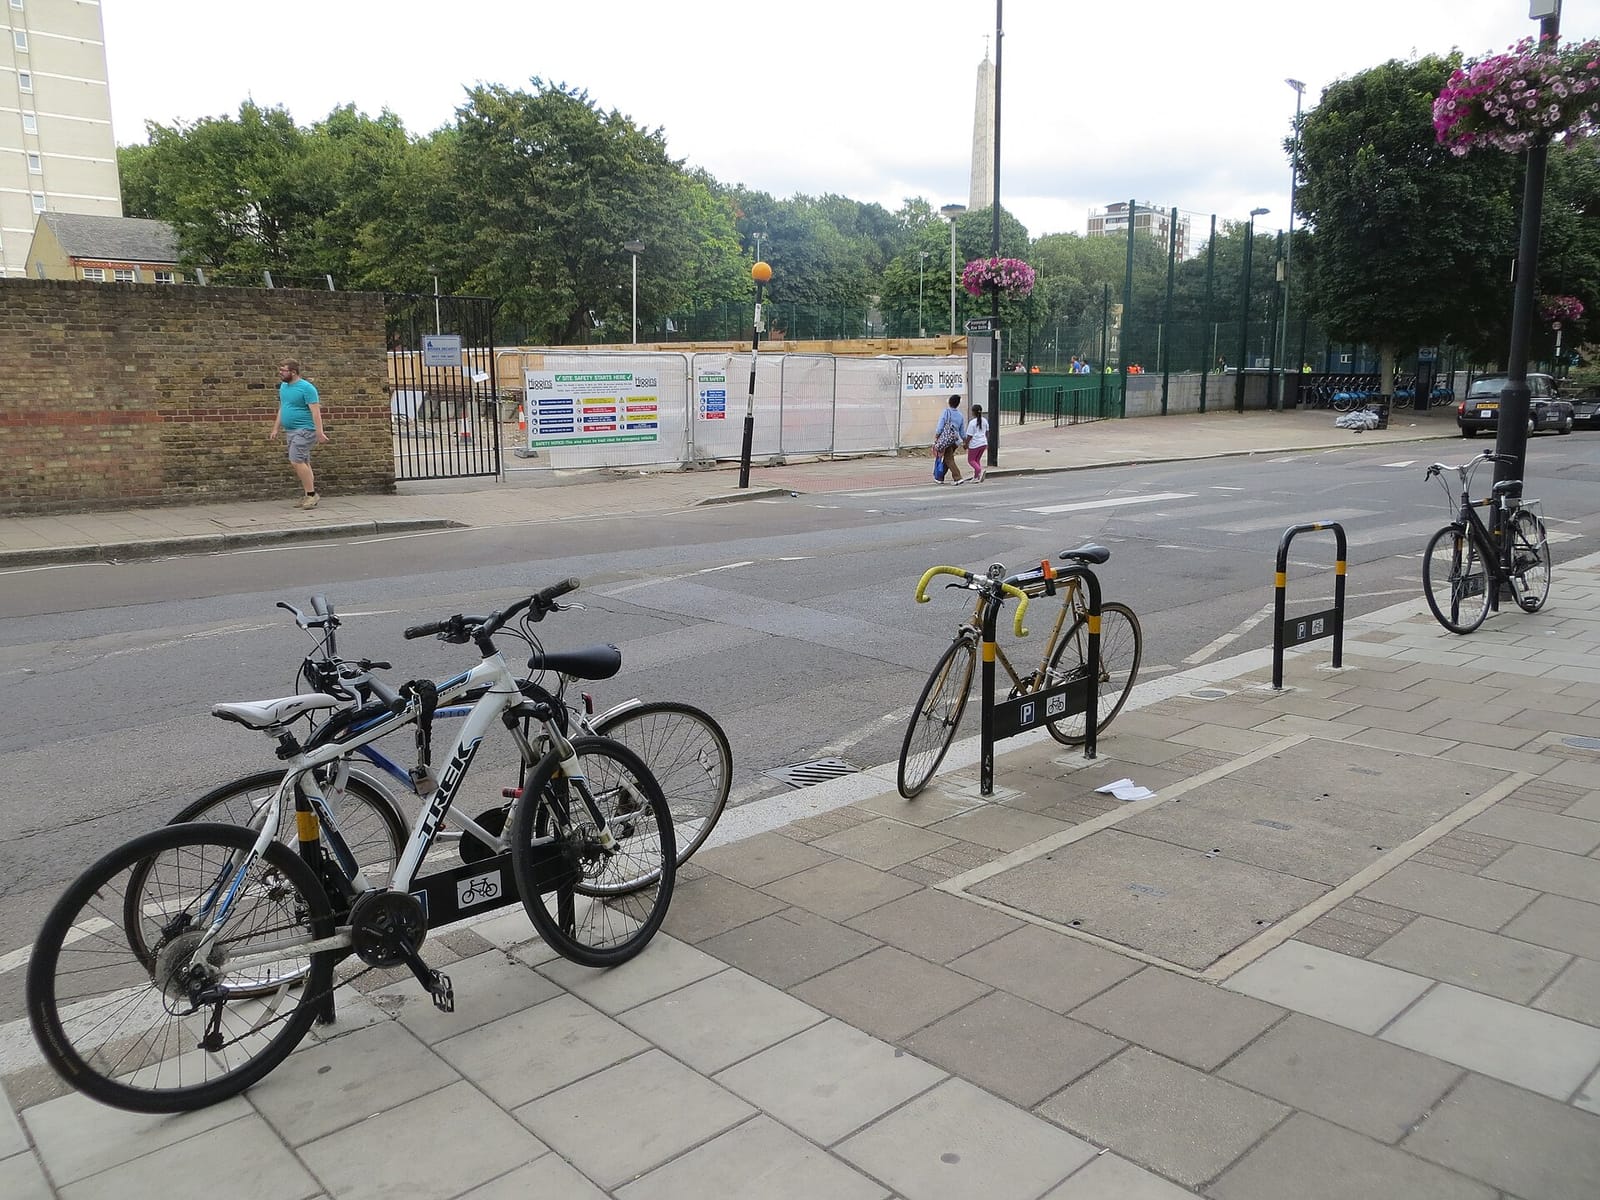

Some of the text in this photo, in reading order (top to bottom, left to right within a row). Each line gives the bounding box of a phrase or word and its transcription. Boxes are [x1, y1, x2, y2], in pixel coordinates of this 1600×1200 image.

[528, 378, 553, 390] Higgins
[635, 376, 657, 388] Higgins
[906, 371, 934, 390] Higgins
[938, 371, 963, 389] Higgins
[1299, 624, 1305, 637] P
[1023, 705, 1032, 723] P
[418, 740, 474, 838] TREK
